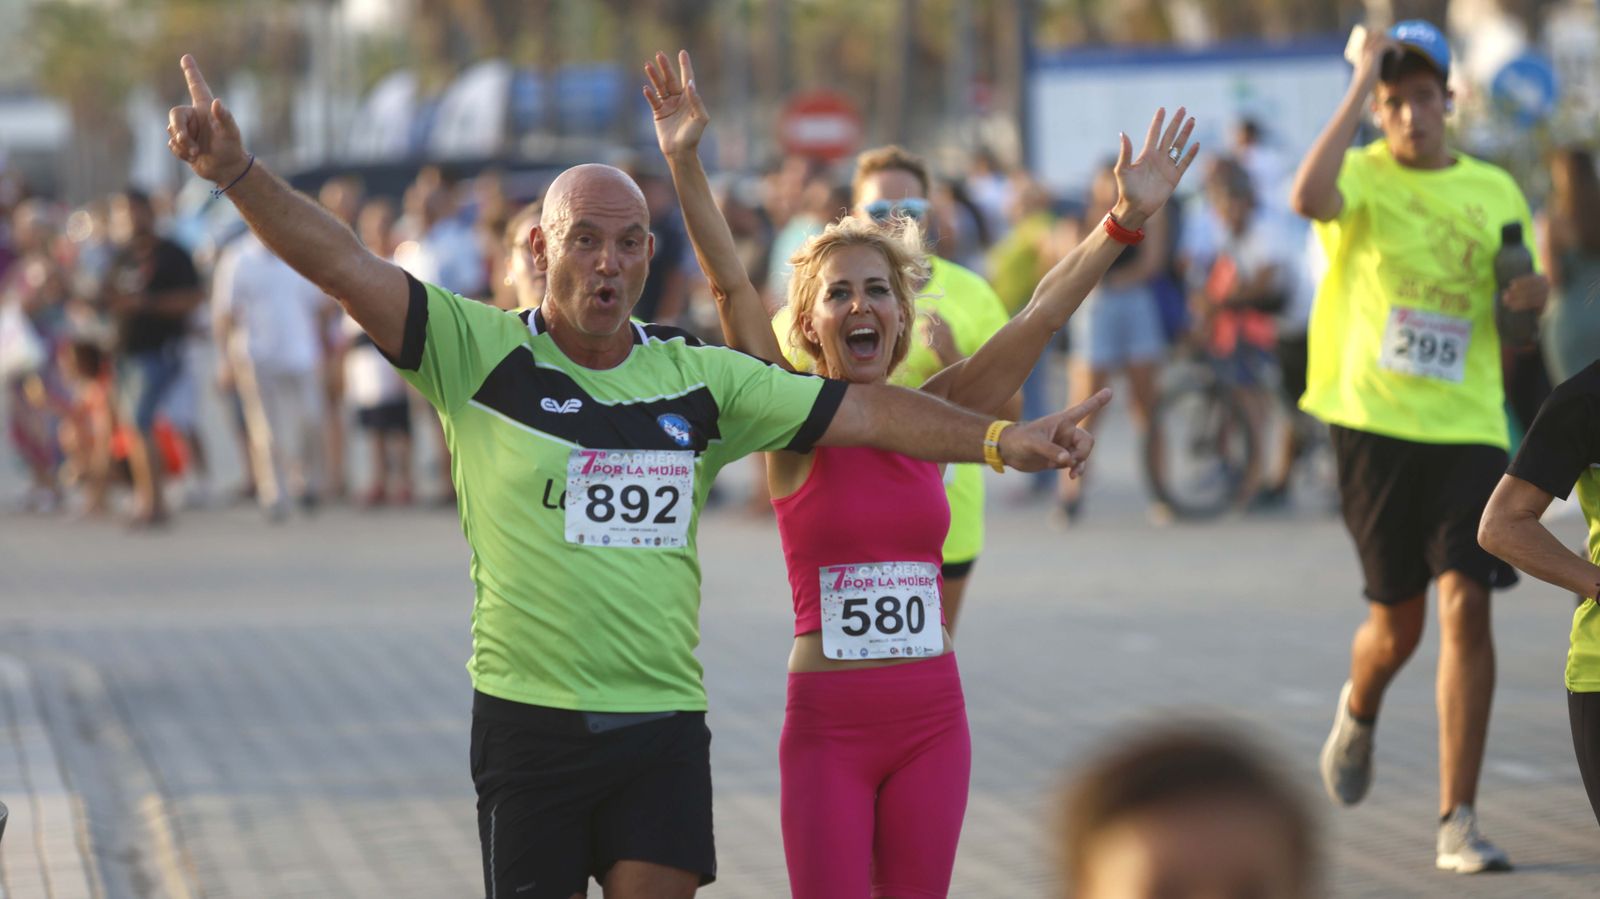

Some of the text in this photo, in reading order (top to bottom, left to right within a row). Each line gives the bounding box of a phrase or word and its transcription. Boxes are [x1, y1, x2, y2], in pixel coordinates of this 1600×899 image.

[1395, 328, 1457, 368] 295
[592, 464, 623, 475] POR
[626, 465, 644, 475] LA
[585, 484, 680, 524] 892
[843, 578, 874, 589] POR
[878, 577, 895, 587] LA
[841, 595, 926, 637] 580
